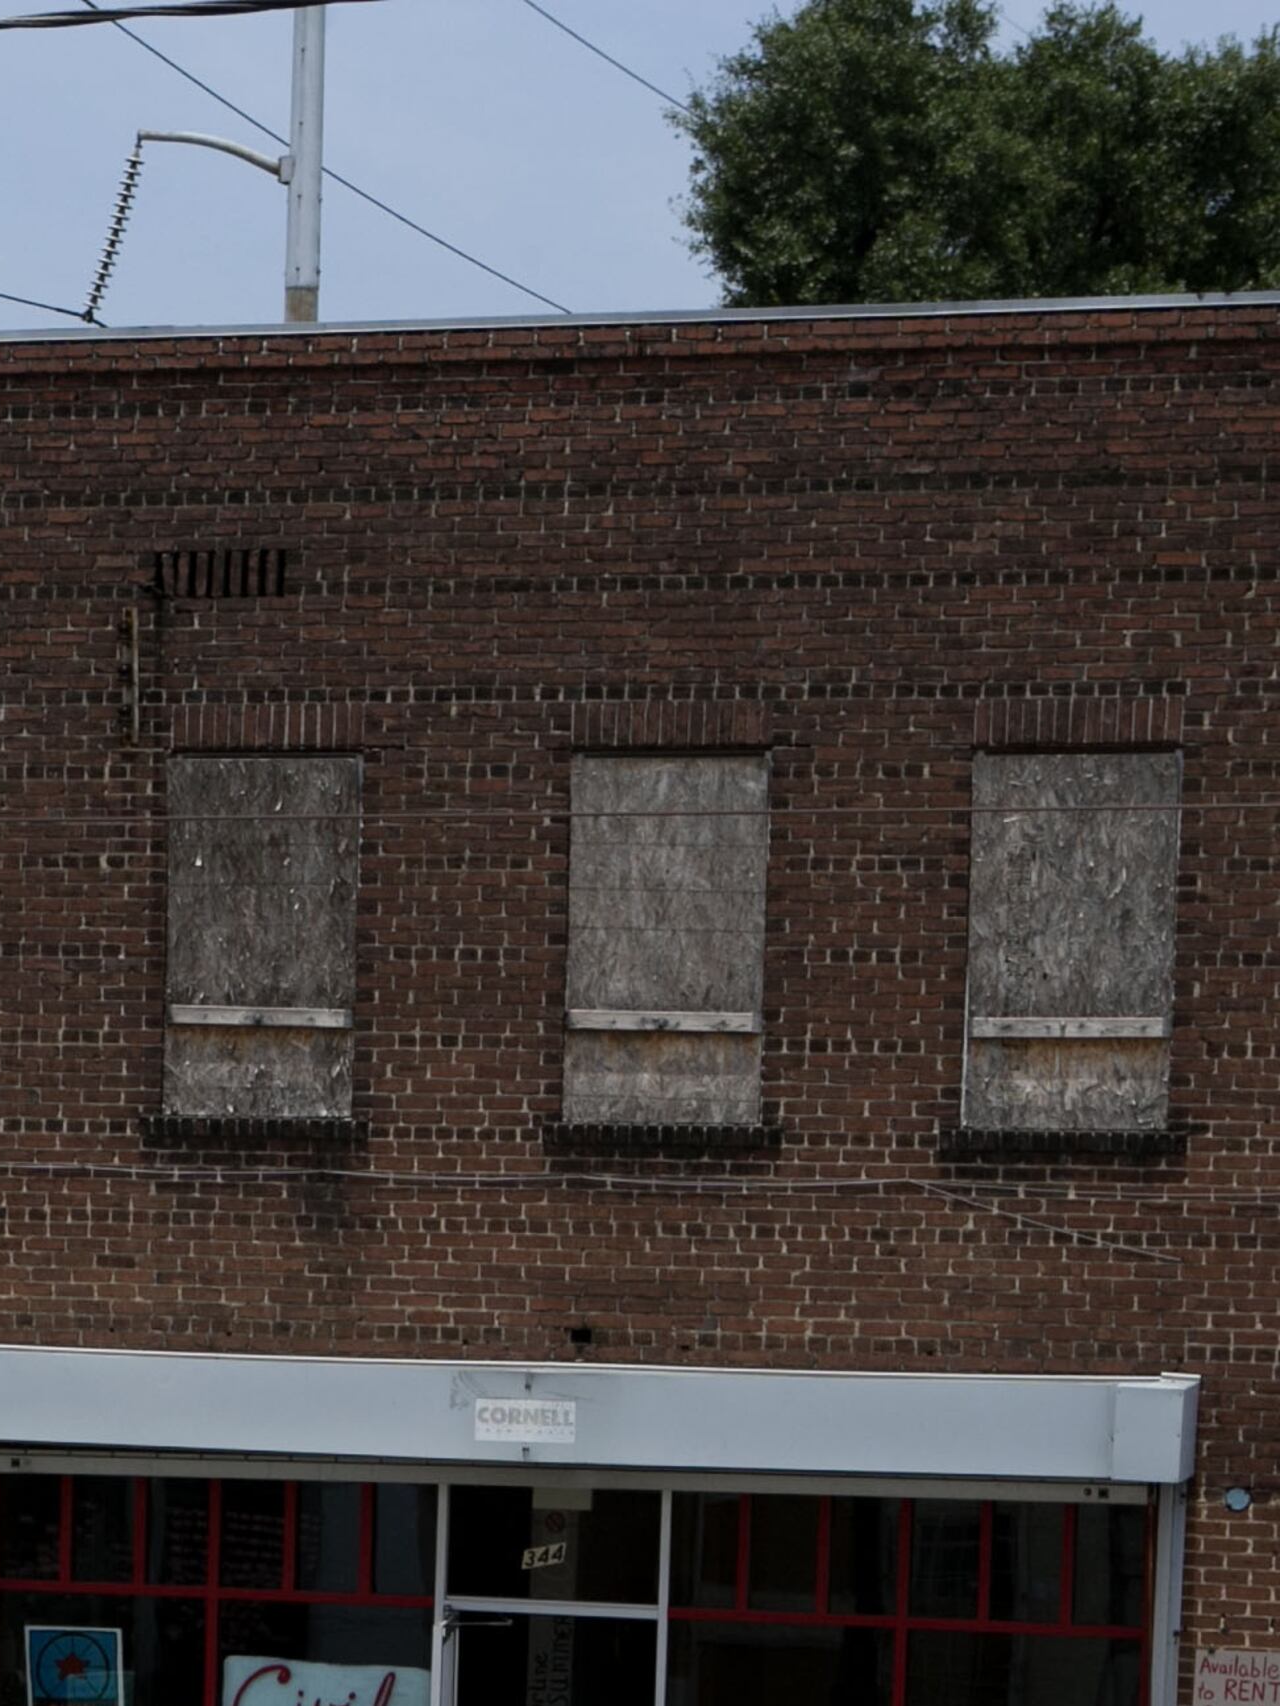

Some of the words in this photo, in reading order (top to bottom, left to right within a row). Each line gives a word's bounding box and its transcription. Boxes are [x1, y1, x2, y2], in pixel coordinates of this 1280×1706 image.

[478, 1407, 574, 1426] CORNELL
[524, 1544, 564, 1567] 344
[1200, 1654, 1280, 1680] Available
[1198, 1681, 1215, 1701] to
[1224, 1678, 1280, 1703] RENT
